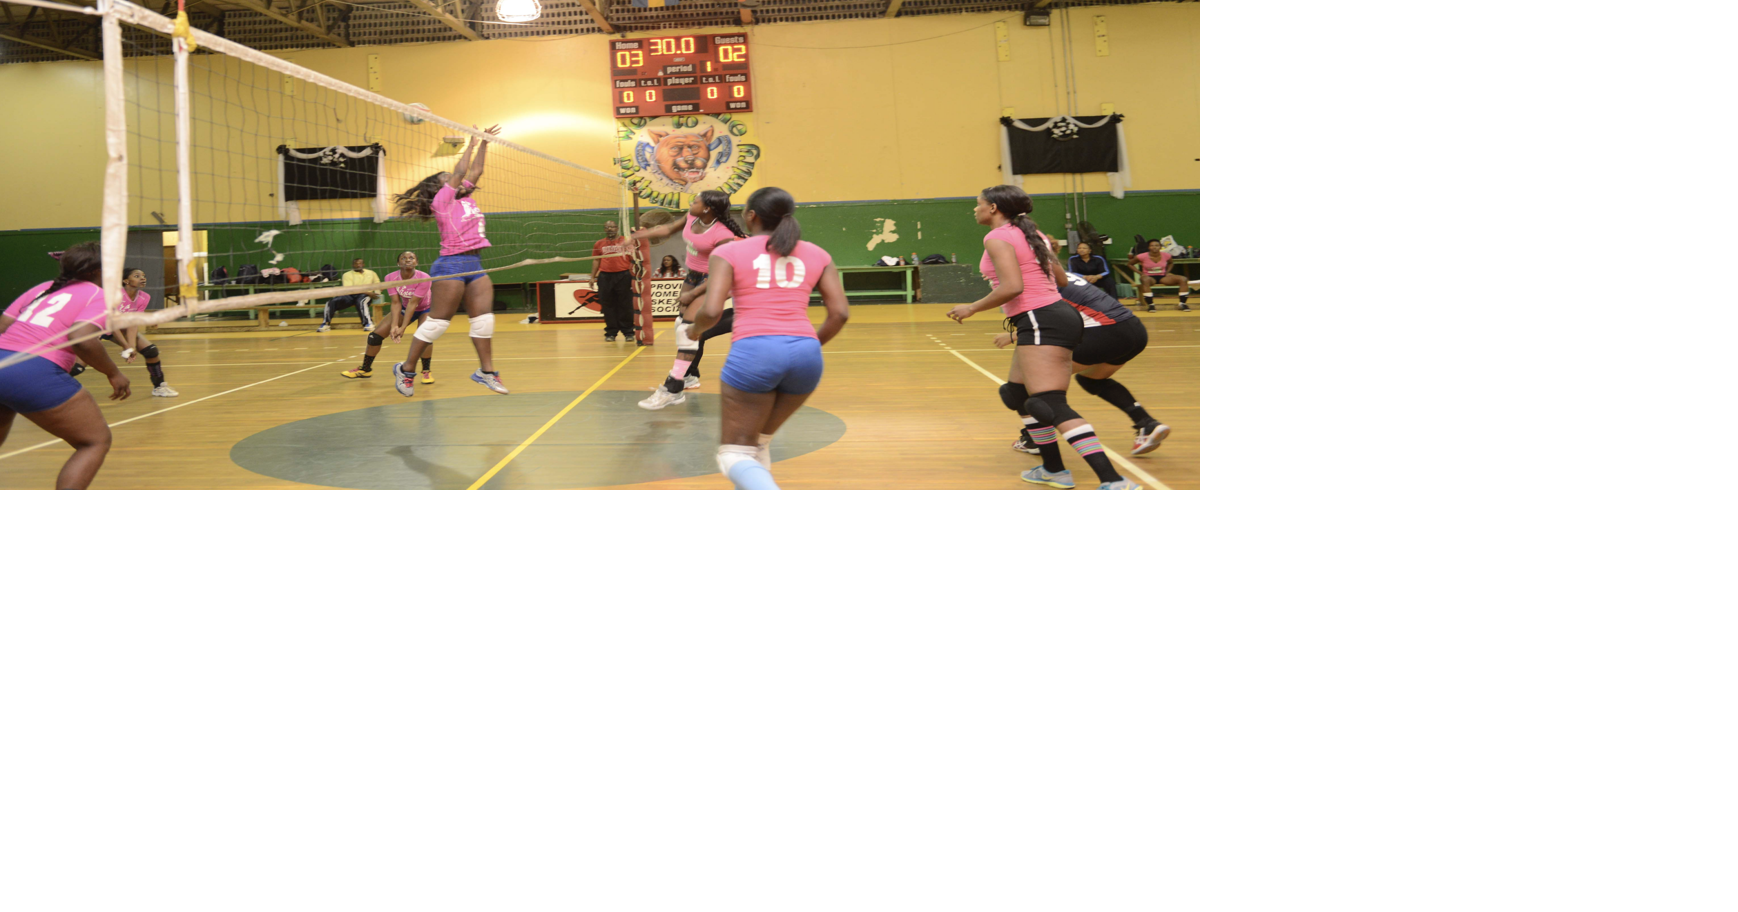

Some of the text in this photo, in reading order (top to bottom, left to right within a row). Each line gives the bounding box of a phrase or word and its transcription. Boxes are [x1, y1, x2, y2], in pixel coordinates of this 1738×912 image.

[615, 41, 639, 50] Home
[649, 37, 695, 56] 30.0
[714, 36, 744, 45] Guests
[616, 50, 644, 68] 03
[718, 44, 746, 62] 02
[666, 64, 693, 74] period
[706, 61, 712, 72] 1
[615, 79, 636, 88] fouls
[666, 77, 695, 86] player
[725, 73, 746, 82] fouls
[623, 90, 634, 103] 0
[645, 89, 656, 102] 0
[707, 86, 718, 99] 0
[733, 85, 745, 98] 0
[671, 103, 693, 112] game
[729, 101, 747, 109] won
[752, 253, 806, 289] 10
[17, 290, 72, 328] 12
